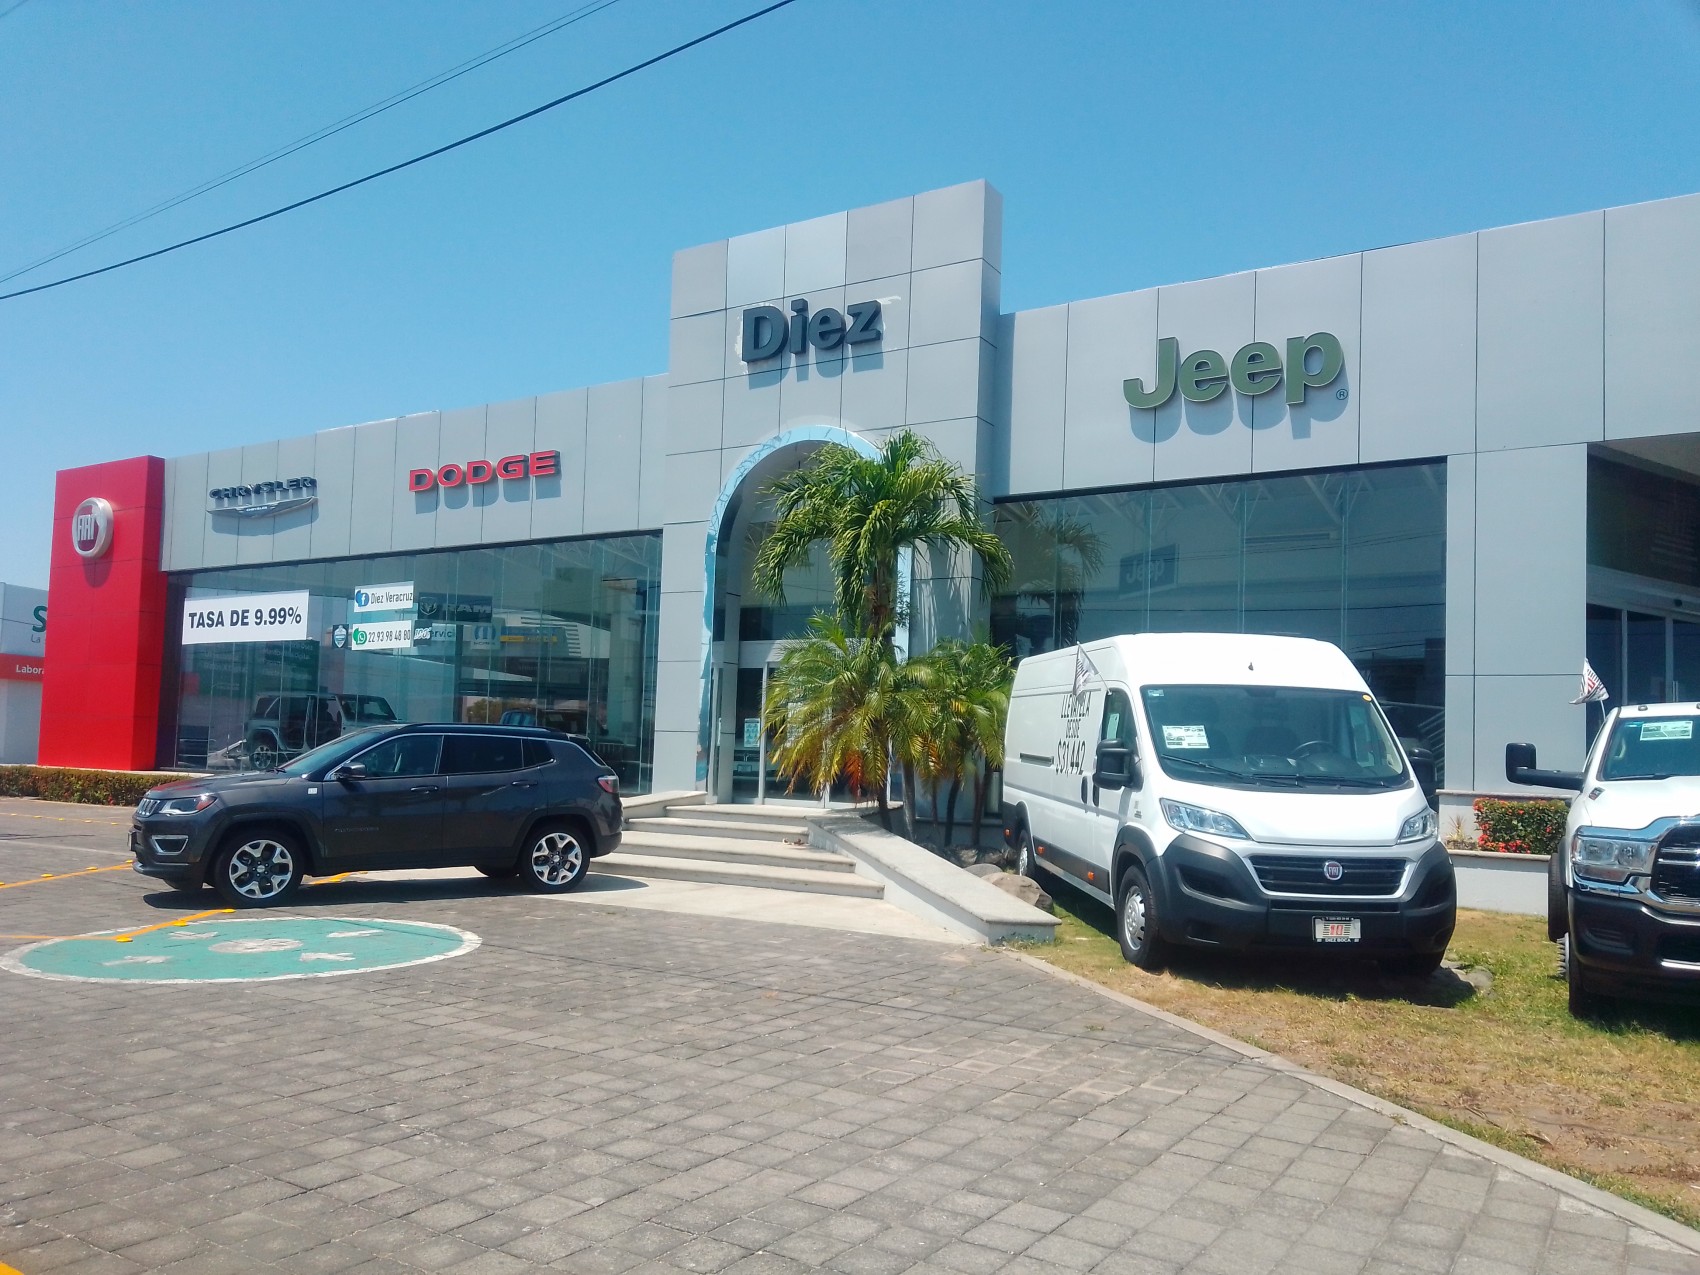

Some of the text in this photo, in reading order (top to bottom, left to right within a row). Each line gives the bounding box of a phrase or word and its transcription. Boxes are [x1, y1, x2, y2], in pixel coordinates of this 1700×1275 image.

[742, 298, 882, 363] Diez
[1123, 331, 1344, 408] Jeep
[409, 450, 561, 492] DODGE
[209, 476, 316, 499] CHRYSLER
[77, 513, 96, 541] FIAT
[370, 592, 384, 604] Diez
[385, 591, 413, 603] Veracruz
[188, 605, 302, 629] TASA DE 9.99%
[368, 631, 376, 643] 22
[376, 630, 384, 642] 93
[1065, 718, 1082, 739] DESDE
[1055, 738, 1086, 778] $31,442
